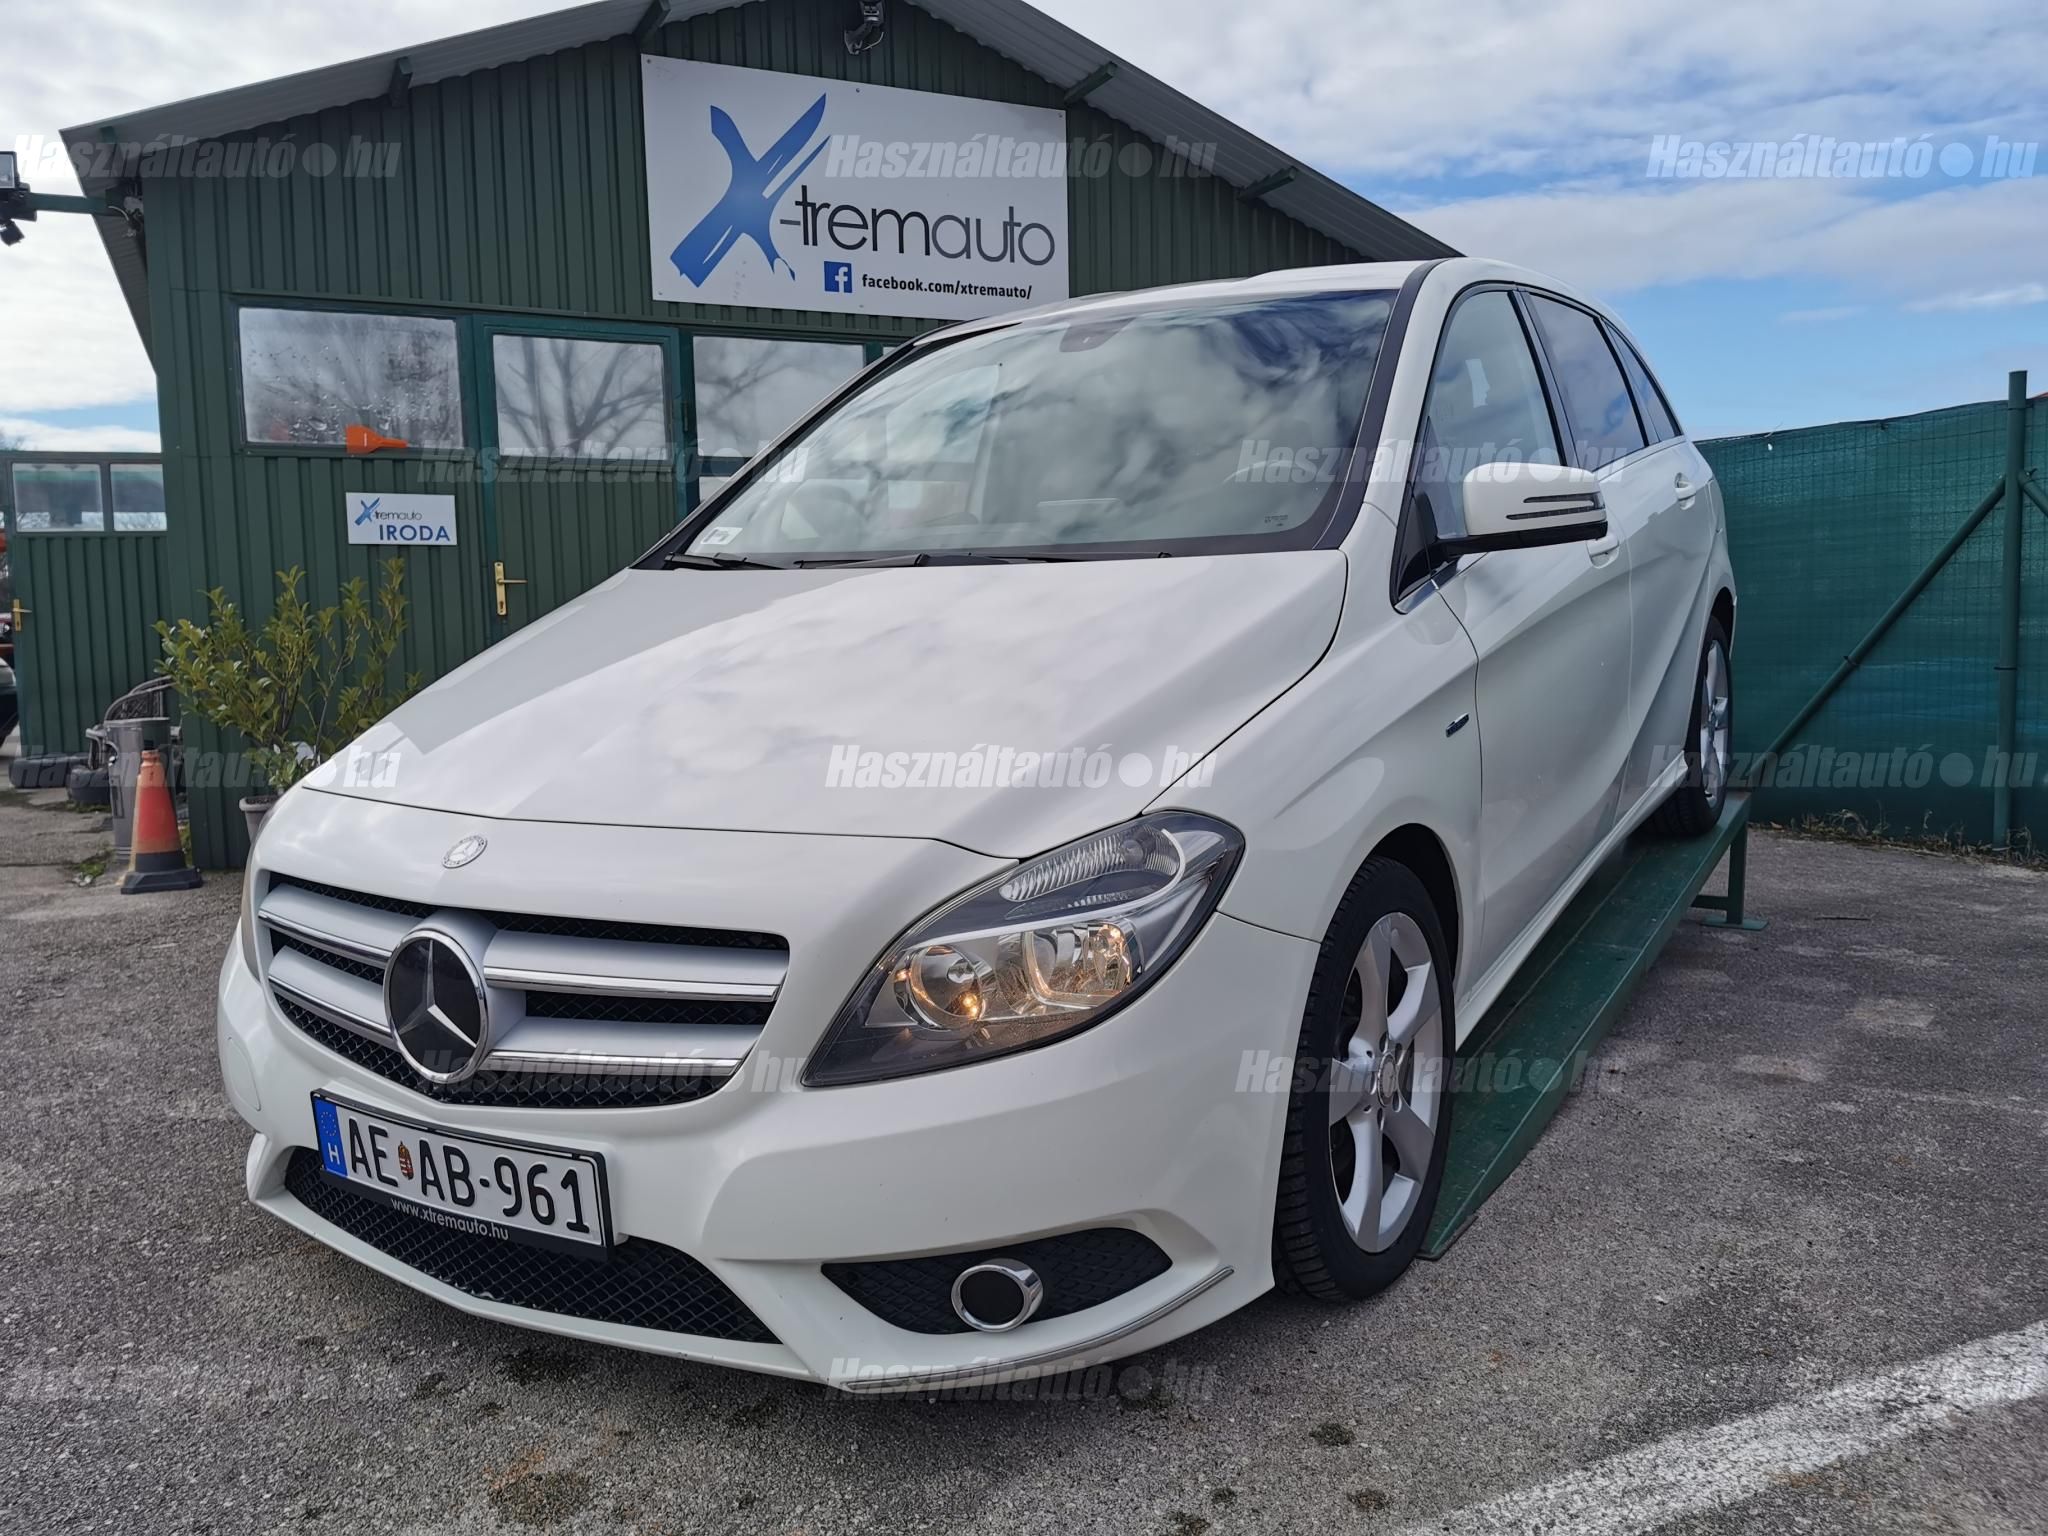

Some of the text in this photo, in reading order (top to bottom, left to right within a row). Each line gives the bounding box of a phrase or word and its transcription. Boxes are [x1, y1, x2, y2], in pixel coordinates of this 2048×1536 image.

[862, 273, 1033, 299] facebook.com/xtremauto/
[379, 524, 450, 541] IRODA
[327, 1142, 340, 1165] H
[419, 1139, 590, 1233] AB-961
[391, 1199, 509, 1241] www.xtremauto.hu
